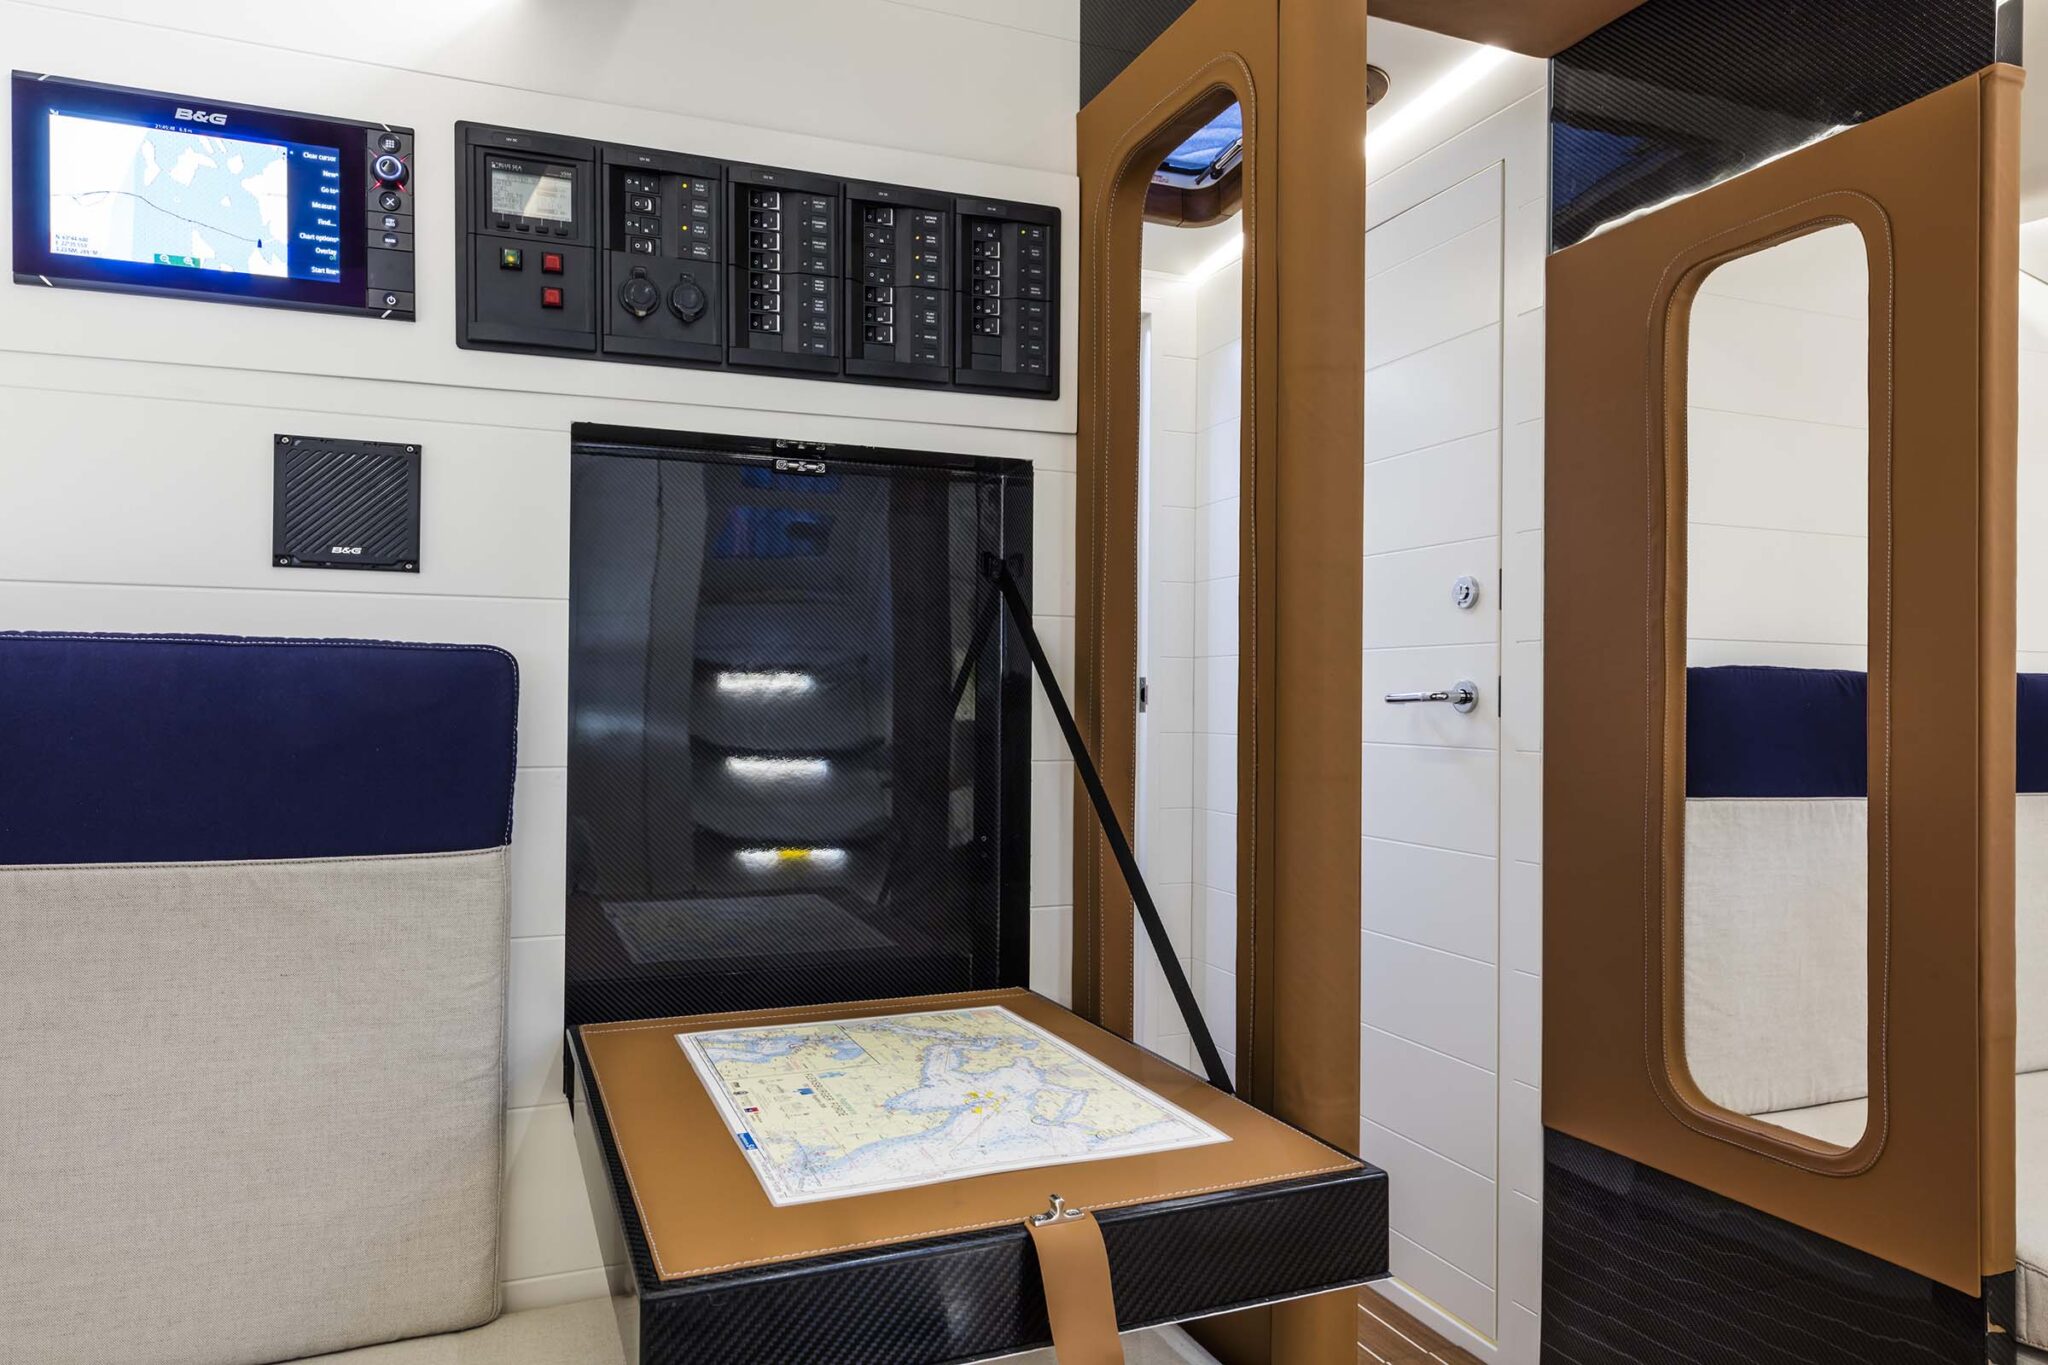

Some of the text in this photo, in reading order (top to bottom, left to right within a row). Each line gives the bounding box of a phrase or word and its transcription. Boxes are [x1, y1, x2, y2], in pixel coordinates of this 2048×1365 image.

[175, 108, 228, 126] B&G
[303, 151, 318, 159] Clear
[312, 201, 336, 210] Measure
[316, 234, 337, 242] options
[315, 247, 337, 256] Overlay
[331, 546, 363, 555] B&G
